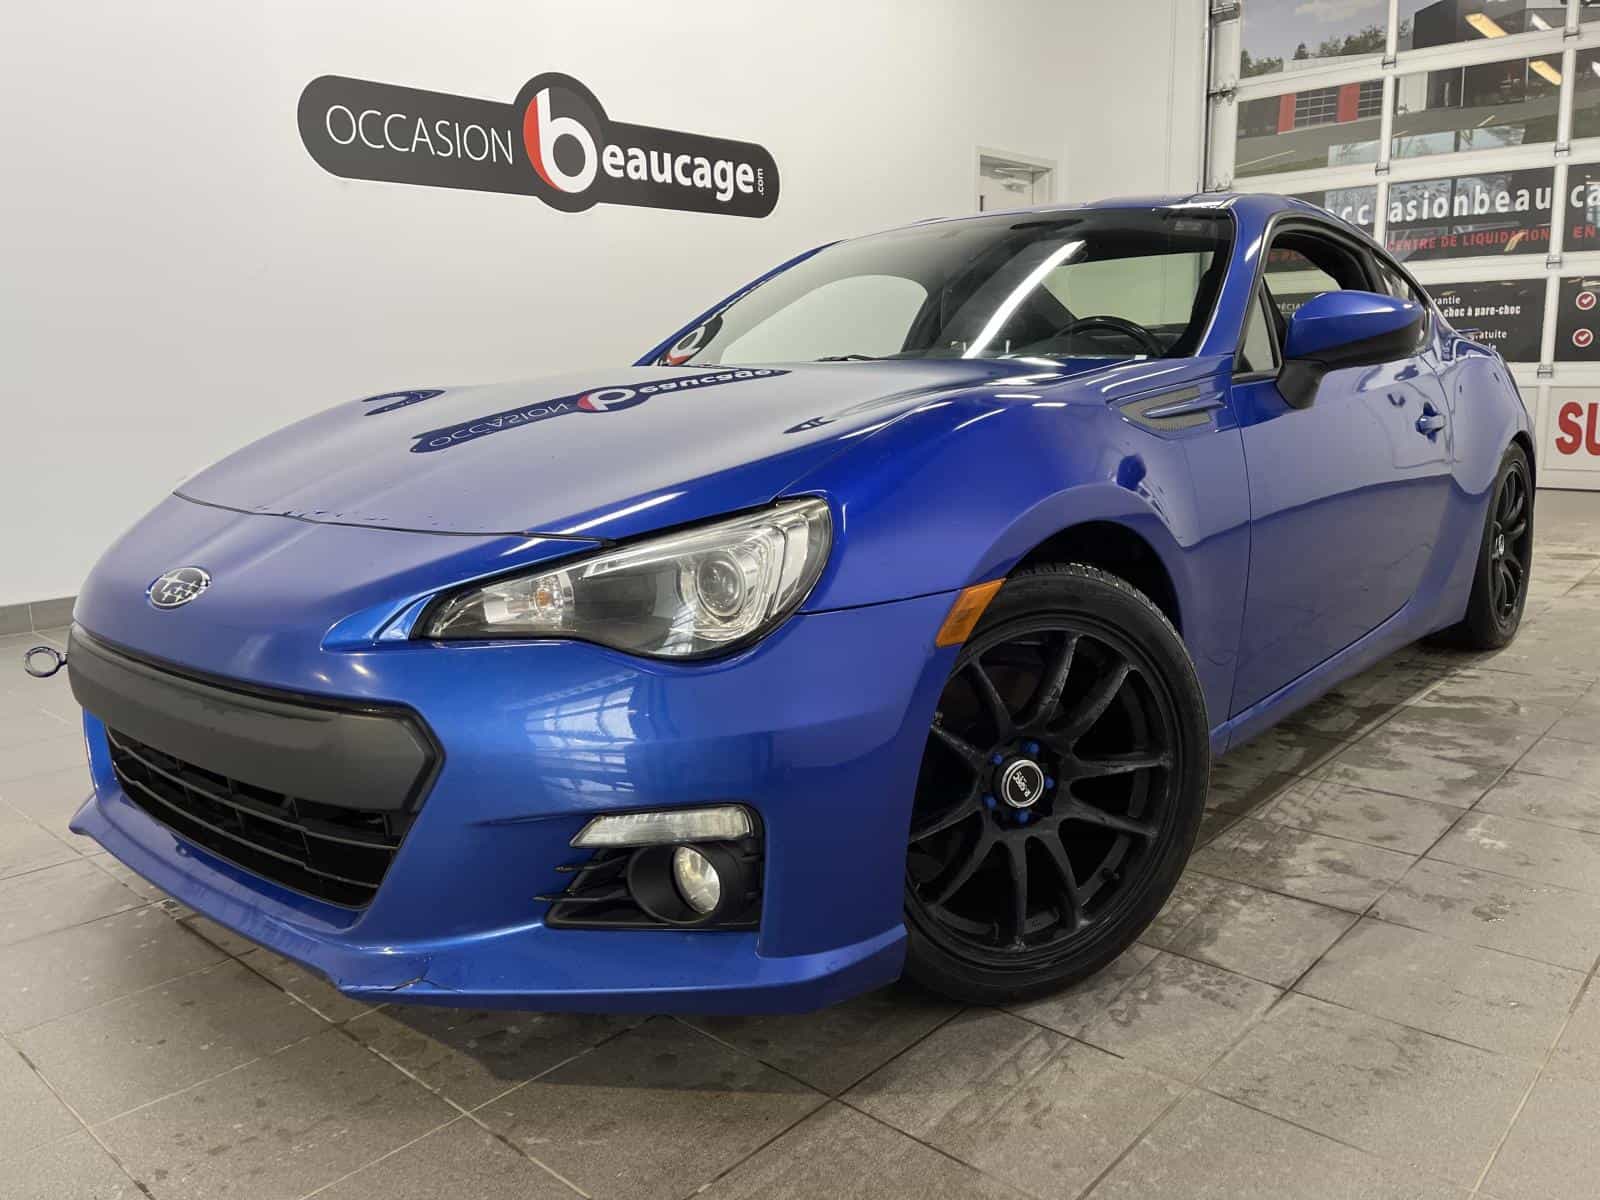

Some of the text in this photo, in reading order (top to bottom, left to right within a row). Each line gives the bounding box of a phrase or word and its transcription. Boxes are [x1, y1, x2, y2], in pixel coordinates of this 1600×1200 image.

[325, 104, 514, 165] OCCASION
[1440, 235, 1457, 248] DE
[1573, 226, 1596, 239] EN
[1475, 305, 1521, 317] pare-choc
